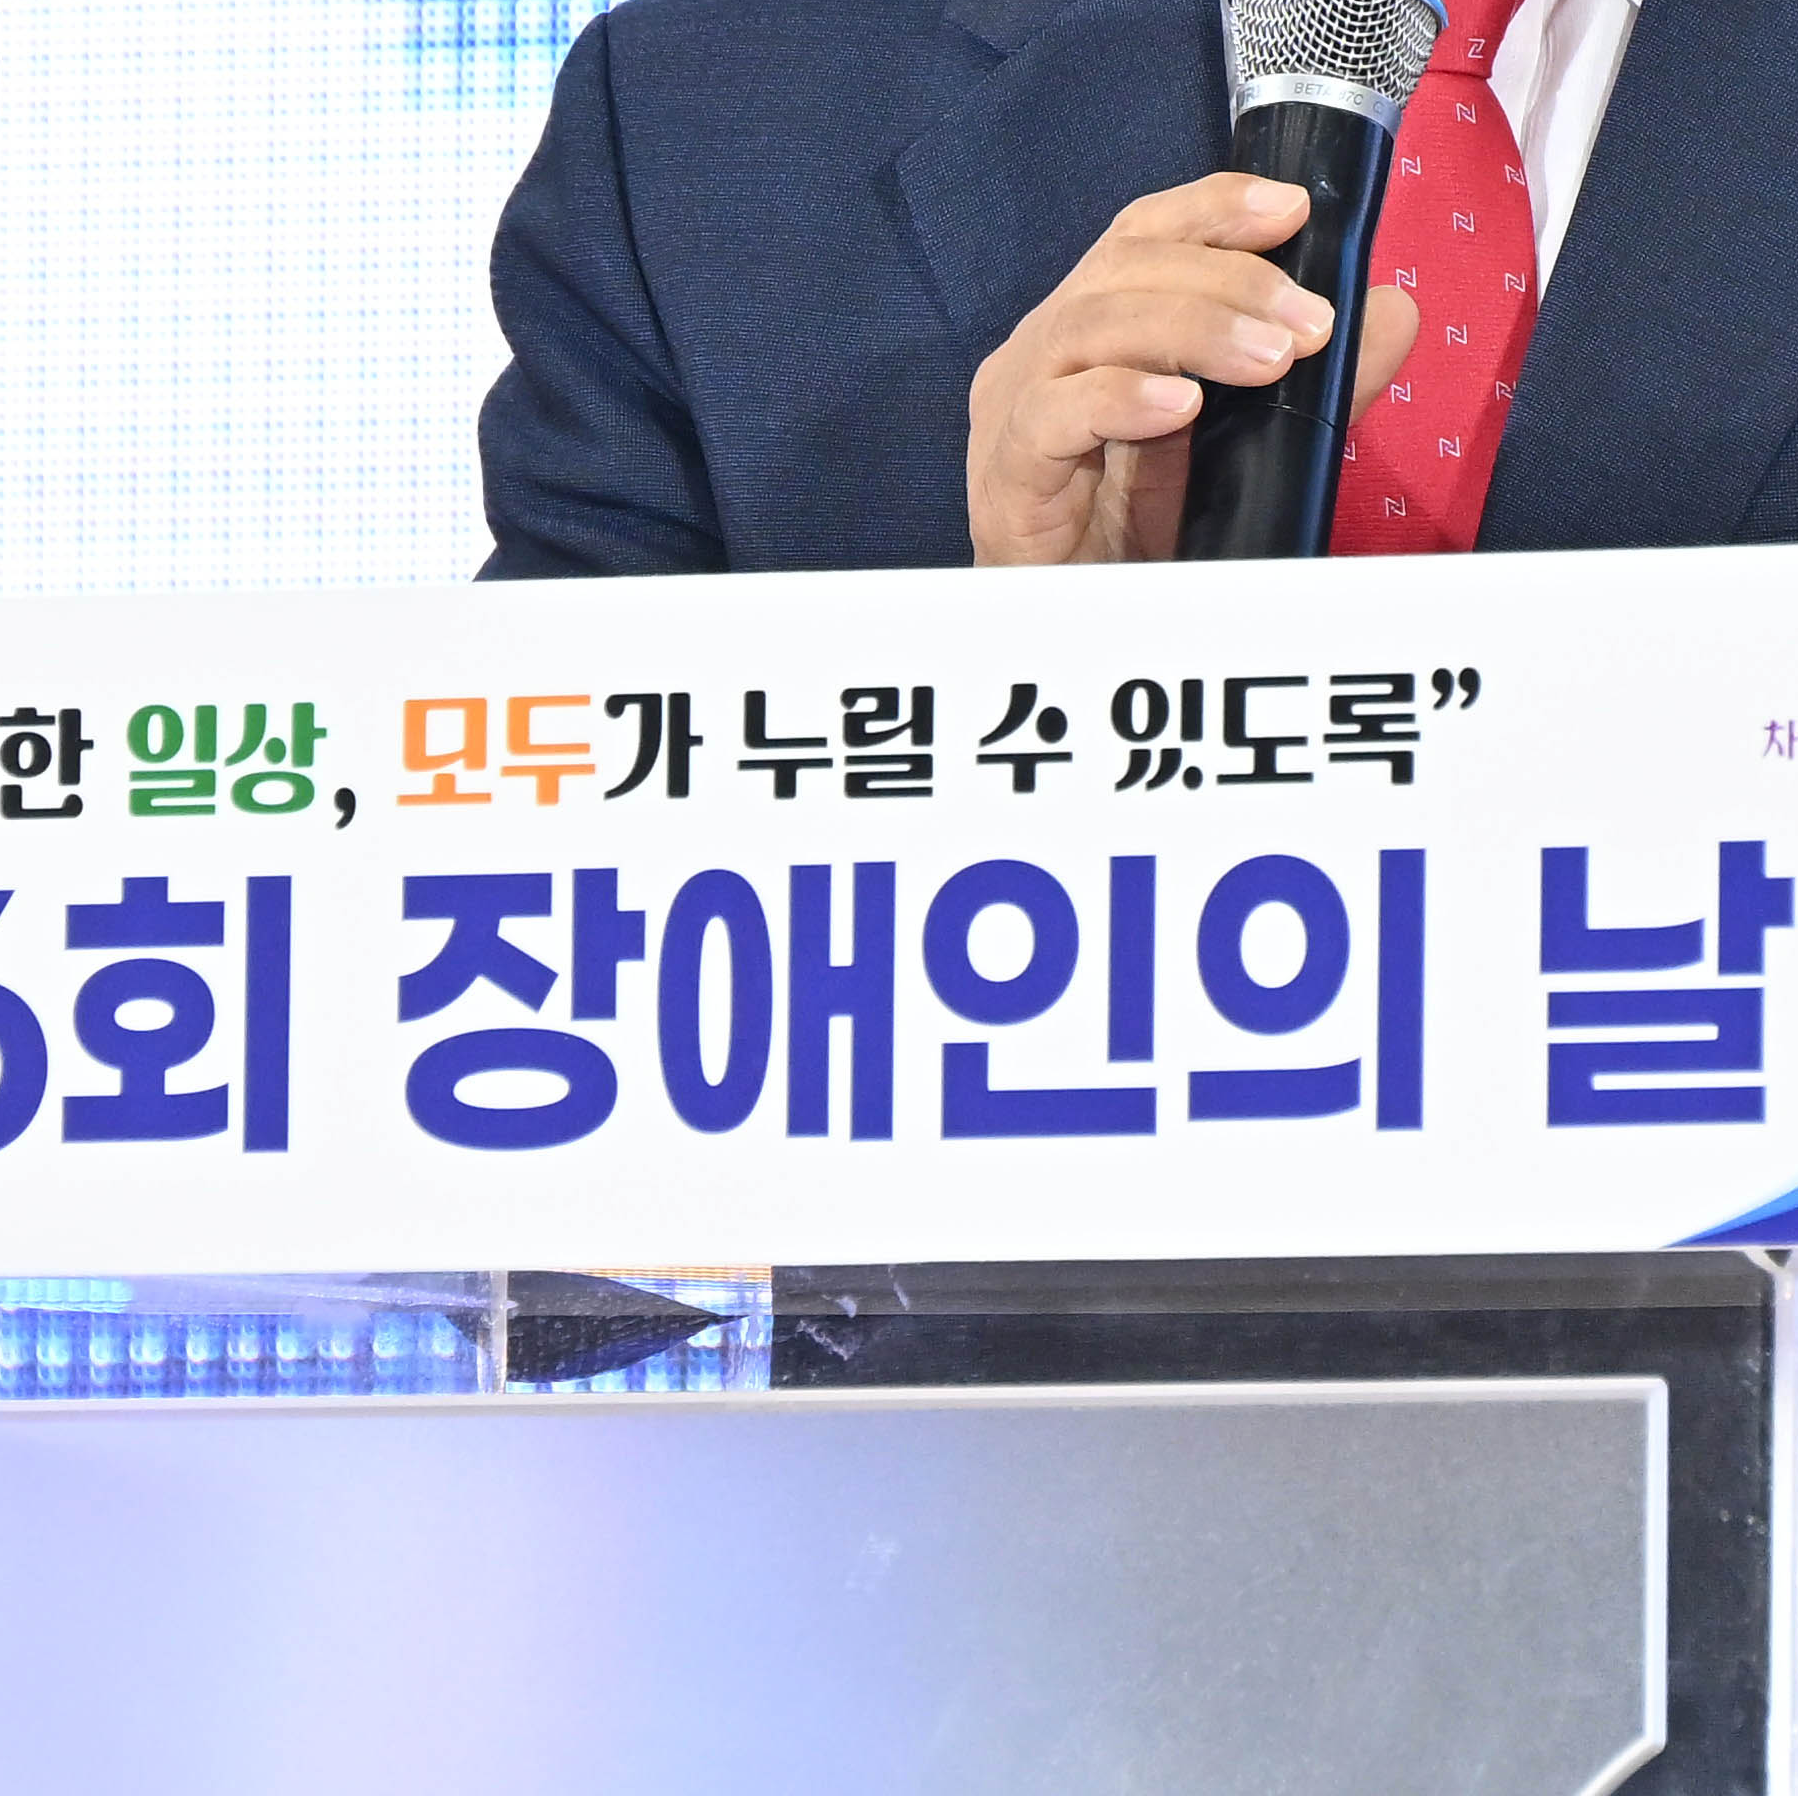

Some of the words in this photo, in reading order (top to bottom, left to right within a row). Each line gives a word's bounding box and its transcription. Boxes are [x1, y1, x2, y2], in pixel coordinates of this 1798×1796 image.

[128, 703, 357, 830] 일상,
[398, 693, 704, 807] 모두가
[738, 687, 935, 801] 누릴
[977, 684, 1074, 795] 수
[1111, 668, 1482, 793] 있도록”
[399, 849, 1427, 1152] 장애인의
[1540, 841, 1796, 1129] 날
